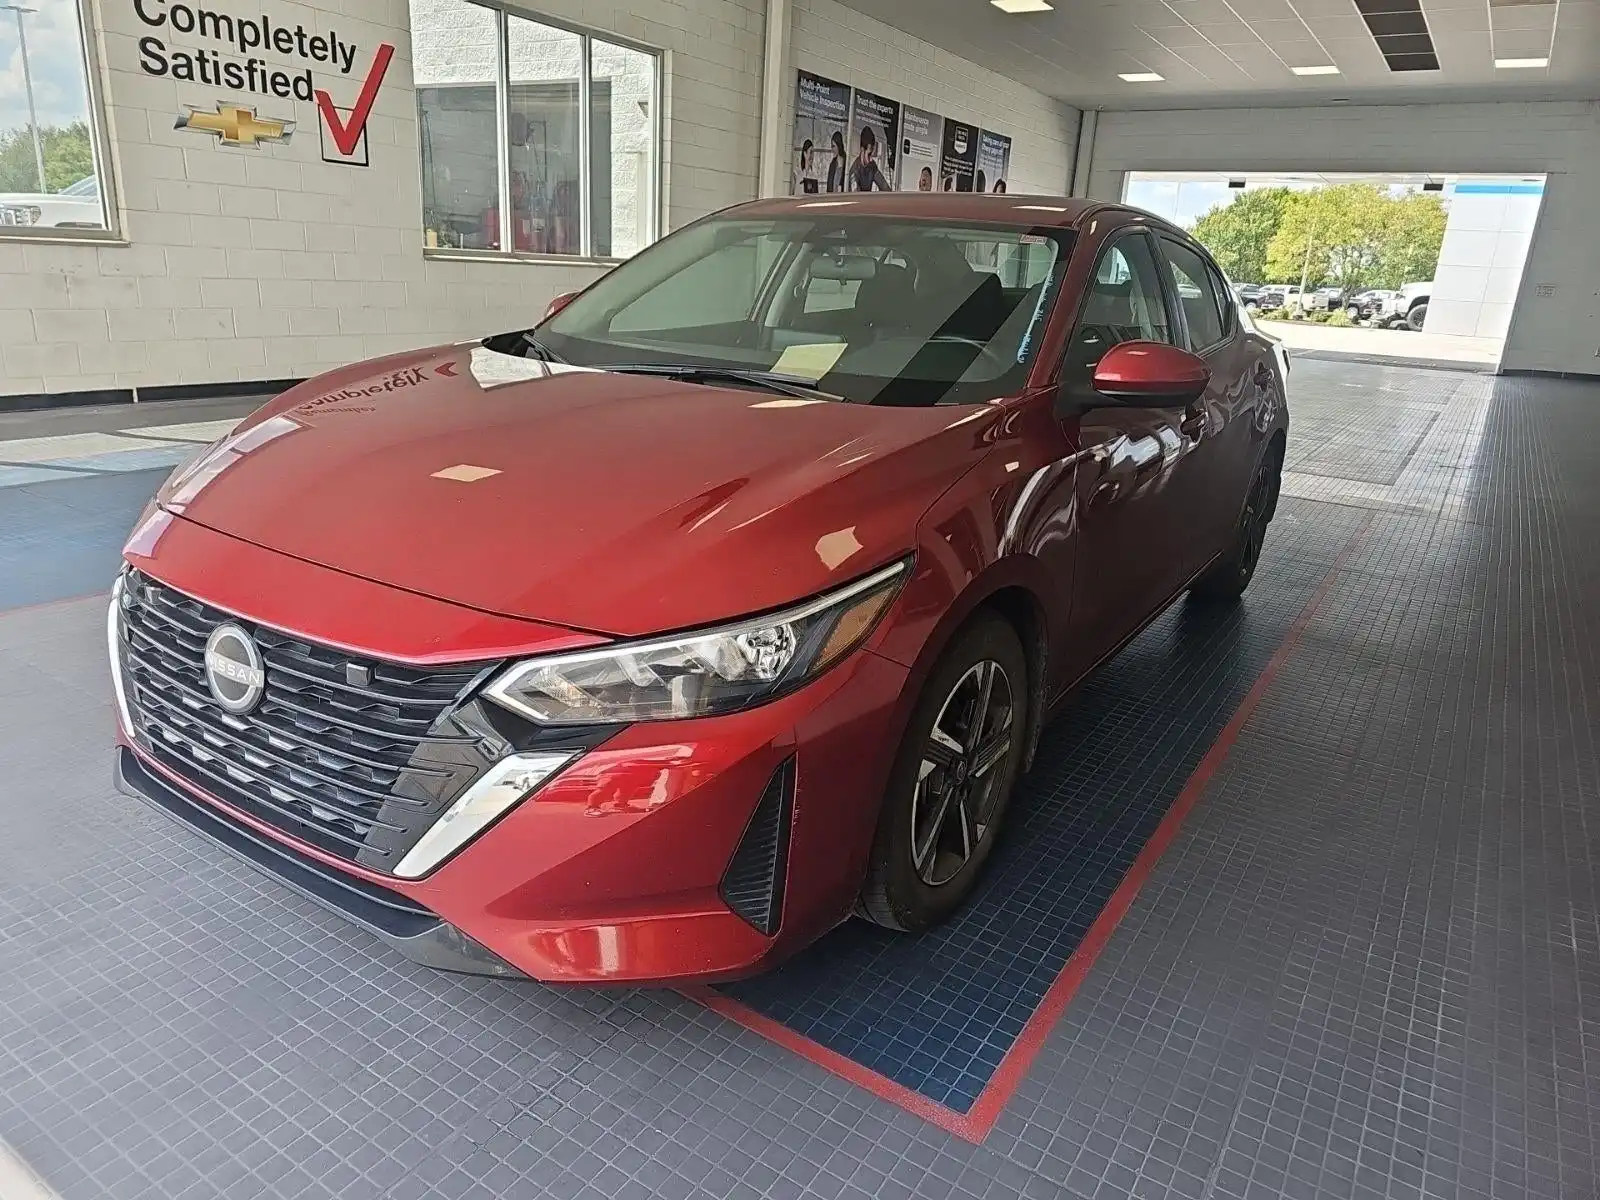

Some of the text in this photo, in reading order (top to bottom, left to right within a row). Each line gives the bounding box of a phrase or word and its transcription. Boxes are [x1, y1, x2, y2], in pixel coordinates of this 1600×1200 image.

[134, 0, 356, 74] Completely
[139, 36, 313, 102] Satisfied
[206, 650, 260, 684] NISSAN
